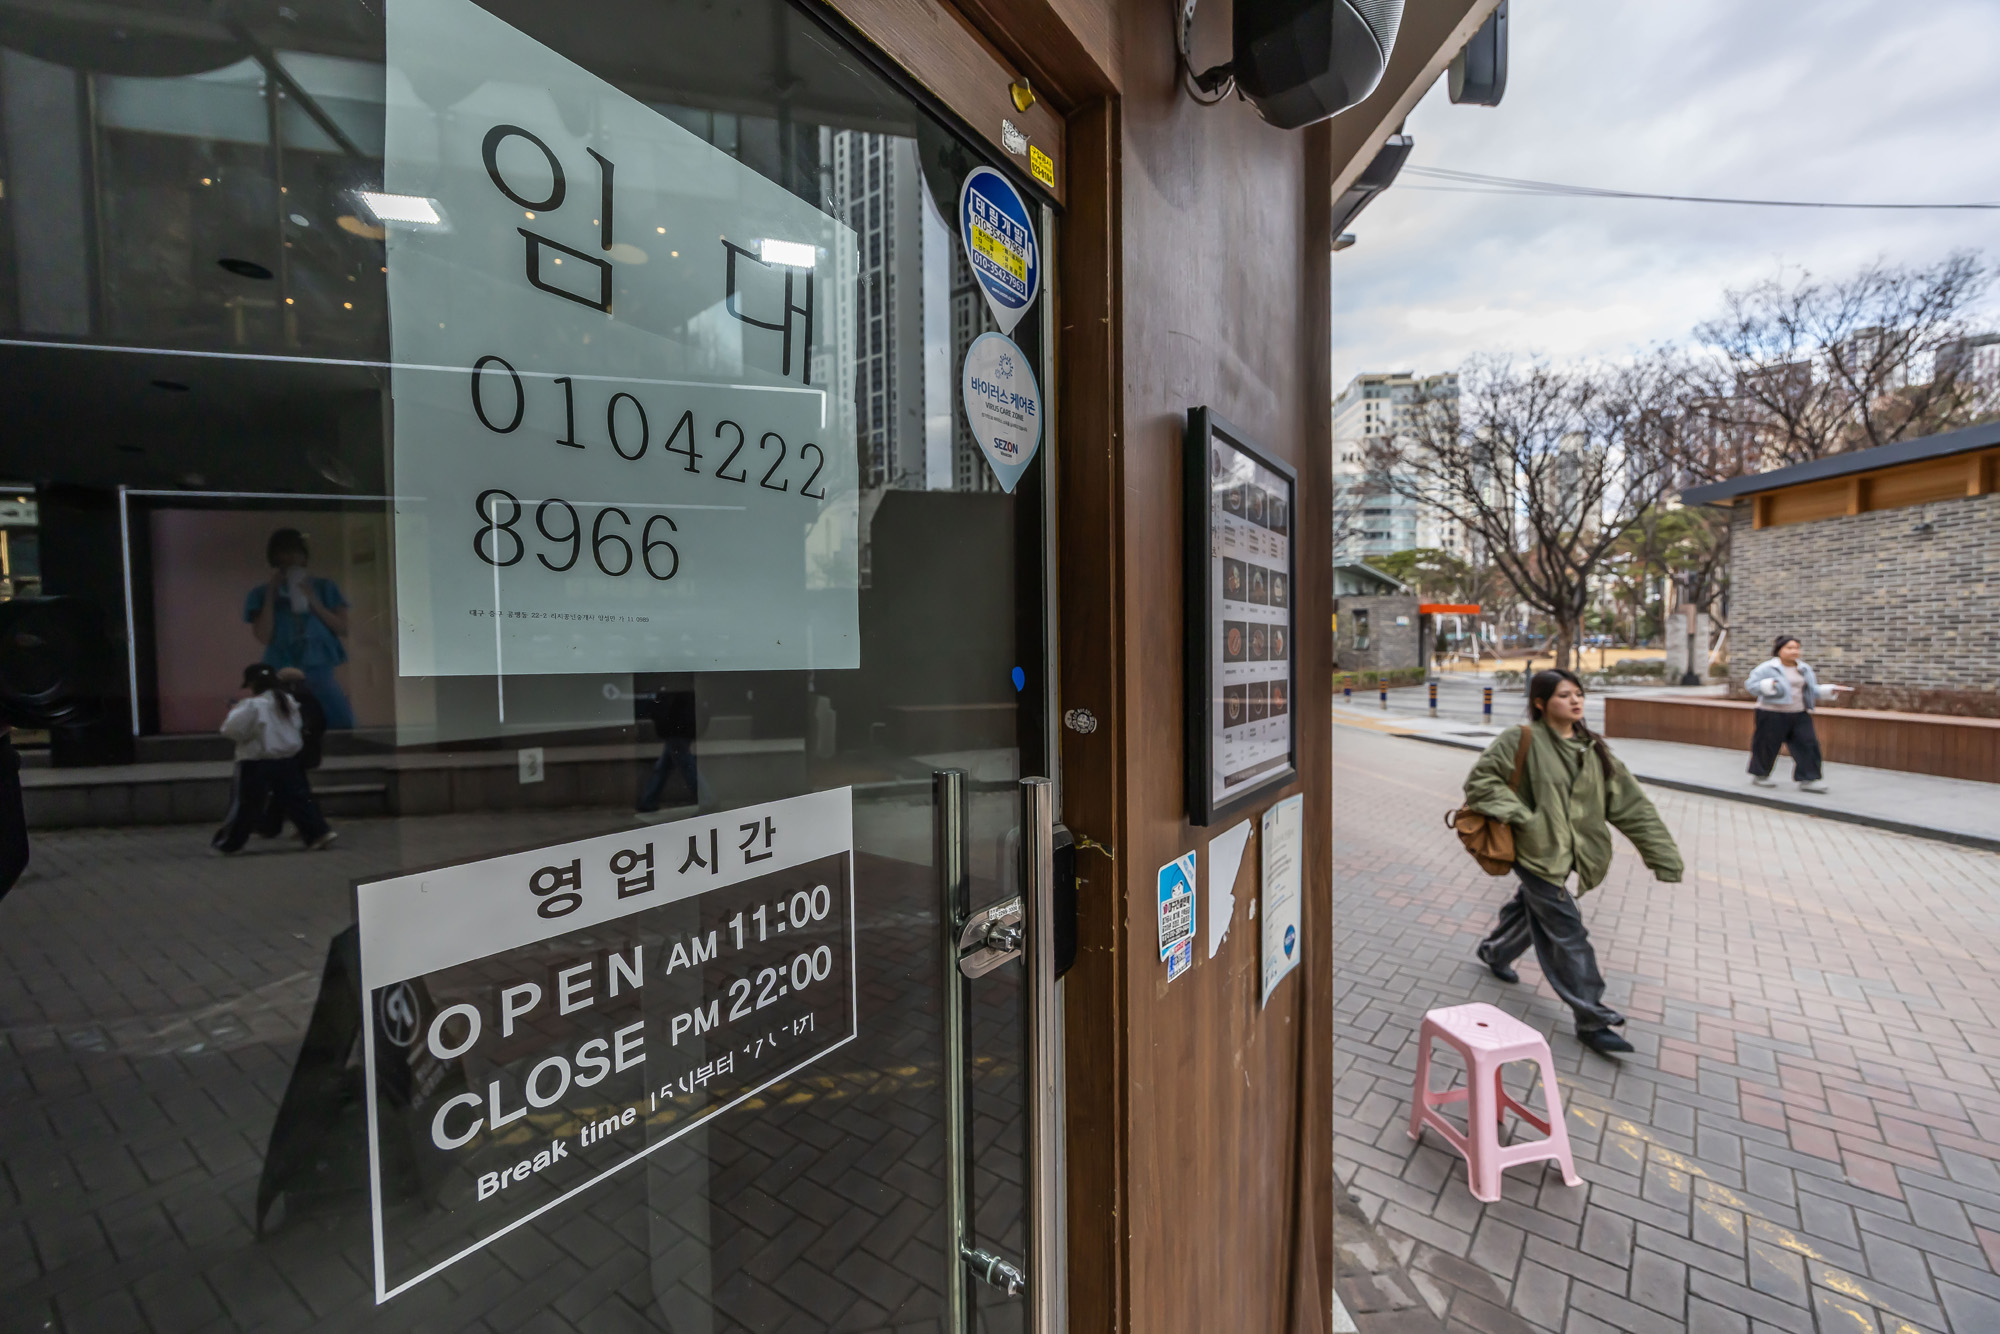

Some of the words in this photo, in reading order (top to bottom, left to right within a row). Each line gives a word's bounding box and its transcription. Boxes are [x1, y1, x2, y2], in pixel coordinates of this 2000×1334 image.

[974, 214, 1024, 258] 010-3542-7963
[975, 196, 1024, 245] 태림개발
[974, 253, 1024, 293] 010-3542-7963
[471, 355, 826, 500] 0104222
[971, 376, 1009, 405] 바이러스
[1010, 391, 1036, 416] 케어존
[985, 401, 999, 414] VIRUS
[999, 406, 1012, 417] CARE
[1012, 410, 1024, 422] ZONE
[994, 437, 1018, 454] SEZON
[473, 489, 679, 580] 8966
[528, 816, 776, 919] 영업시간
[427, 945, 644, 1060] OPEN
[666, 930, 717, 975] AM
[728, 884, 830, 951] 11:00
[431, 1020, 646, 1151] CLOSE
[671, 999, 719, 1046] PM
[728, 944, 832, 1022] 22:00
[478, 1138, 569, 1202] Break
[580, 1104, 637, 1147] time
